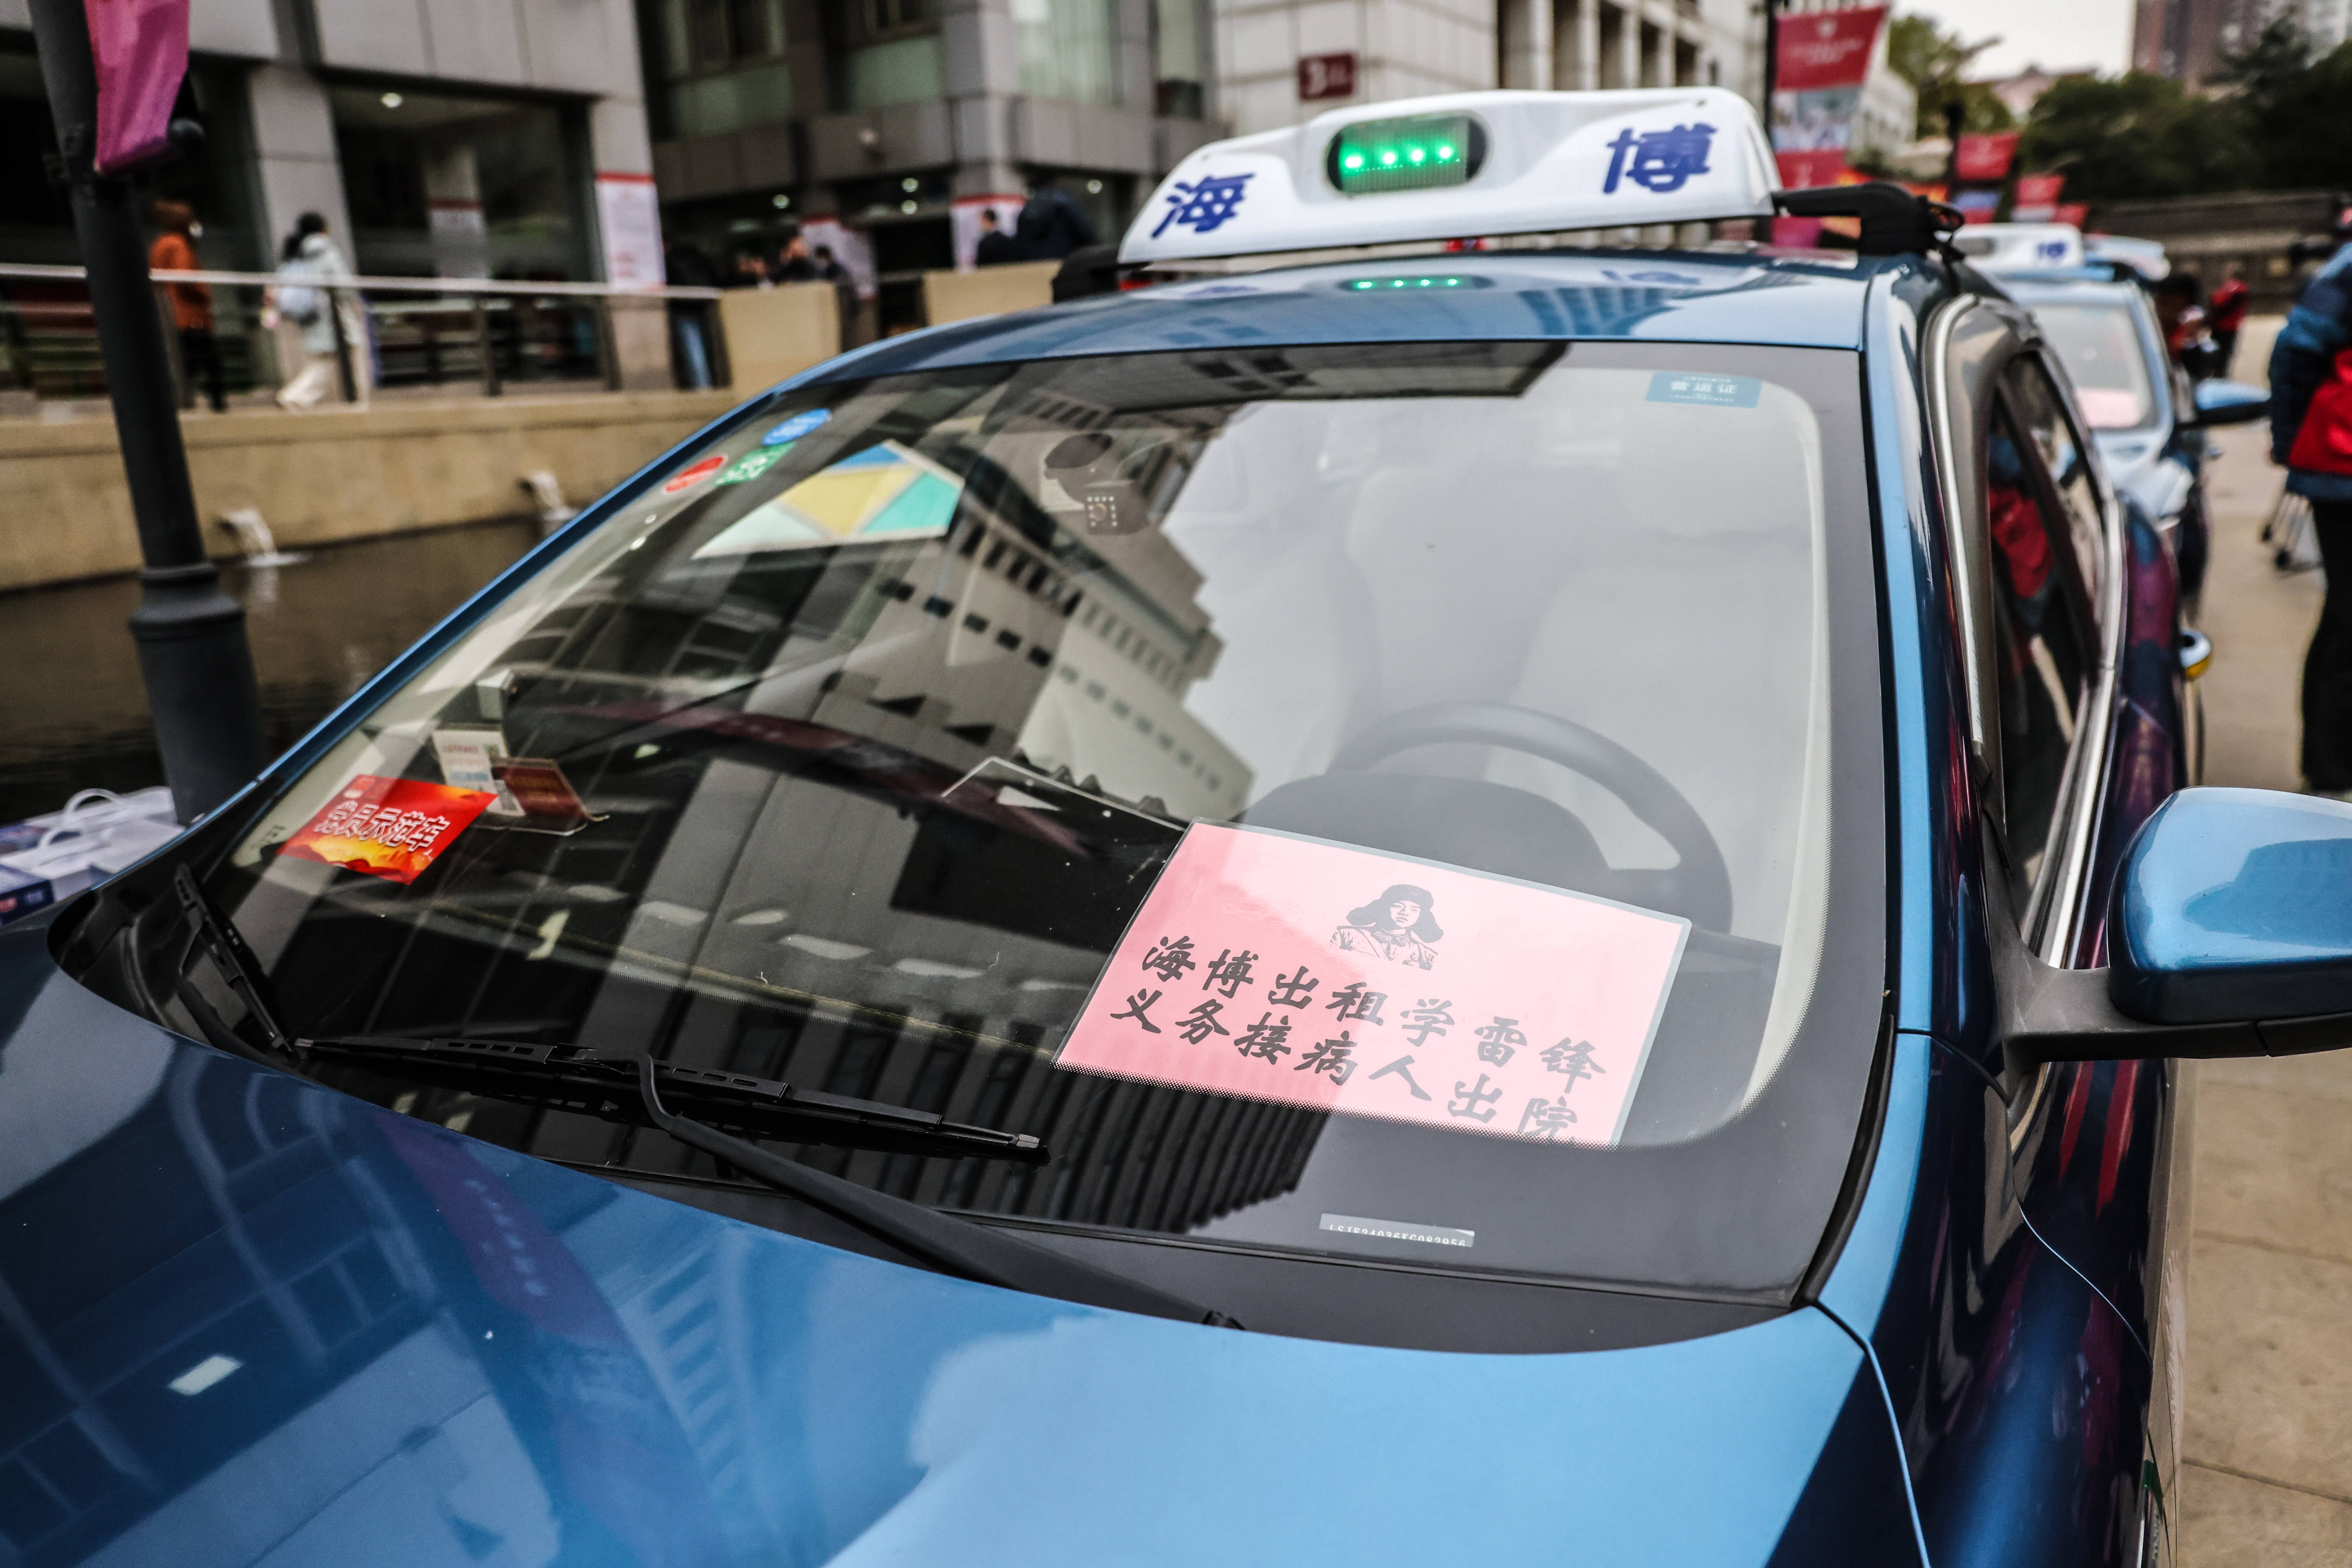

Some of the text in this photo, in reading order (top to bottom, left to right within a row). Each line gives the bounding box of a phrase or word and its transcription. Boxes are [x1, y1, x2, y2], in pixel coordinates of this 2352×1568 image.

[1152, 173, 1254, 238] 海
[1603, 123, 1717, 193] 博
[313, 800, 451, 852] 党员示范车
[1110, 988, 1578, 1144] 义务接病人出院
[1142, 935, 1606, 1094] 海博出租学雷锋
